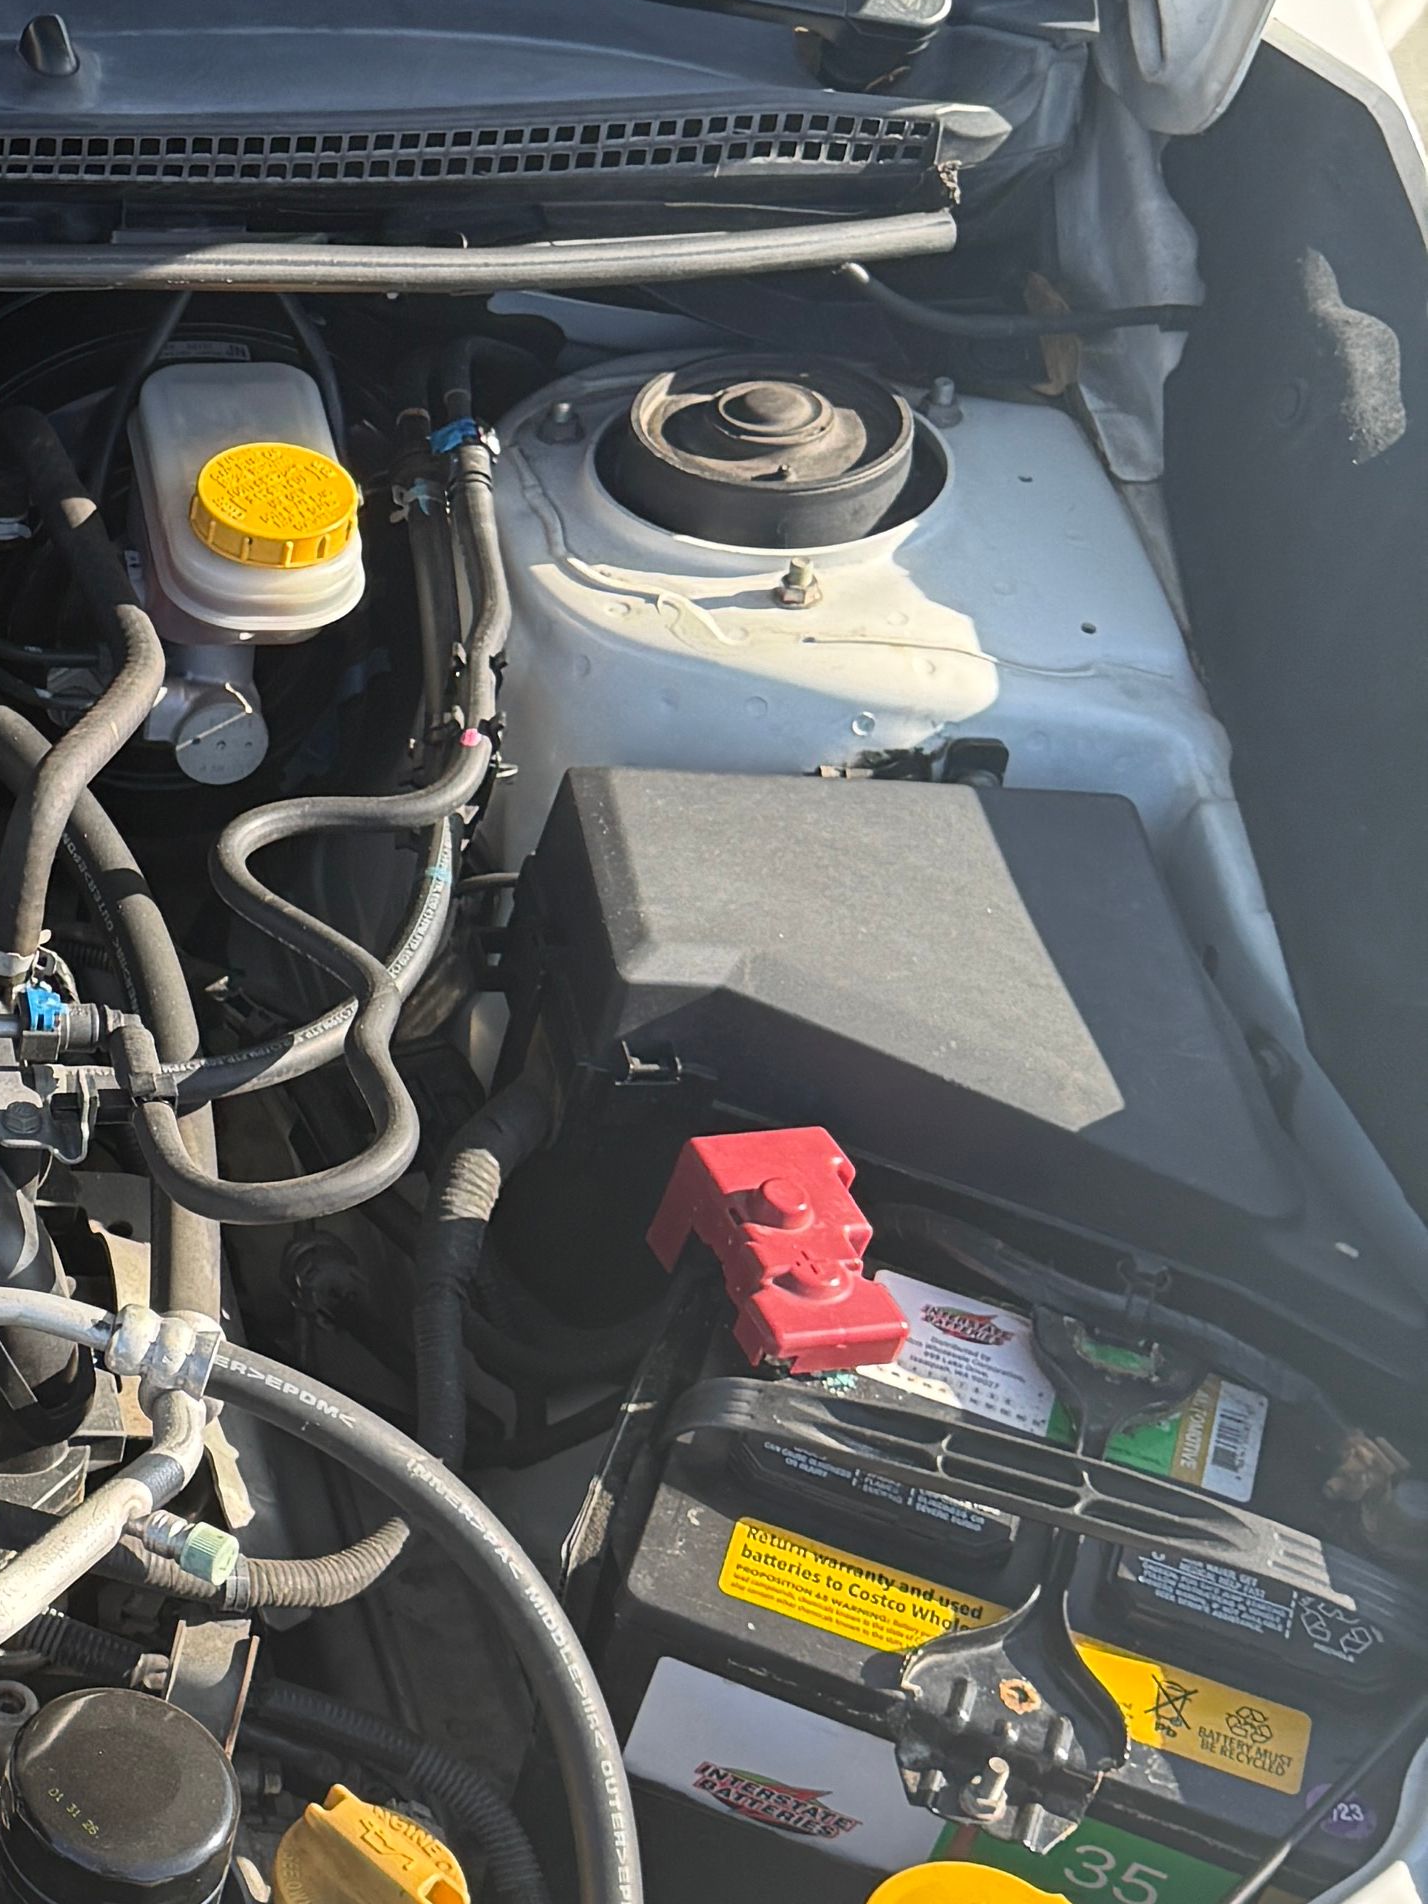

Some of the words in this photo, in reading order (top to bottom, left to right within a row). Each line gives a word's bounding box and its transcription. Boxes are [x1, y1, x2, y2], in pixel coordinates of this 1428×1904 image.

[736, 1563, 813, 1597] PROPOSITION
[831, 1598, 891, 1624] WARNING:
[741, 1543, 821, 1584] batteries
[826, 1573, 843, 1592] to
[848, 1582, 906, 1614] Costco
[746, 1526, 807, 1558] Return
[814, 1551, 896, 1591] warranty
[898, 1580, 934, 1602] and
[938, 1598, 984, 1621] used
[1198, 1726, 1254, 1758] BATTERY
[1255, 1745, 1293, 1769] MUST
[1219, 1744, 1286, 1778] RECYCLED
[692, 1775, 842, 1839] BATTERIES
[695, 1760, 863, 1833] INTERSTATE
